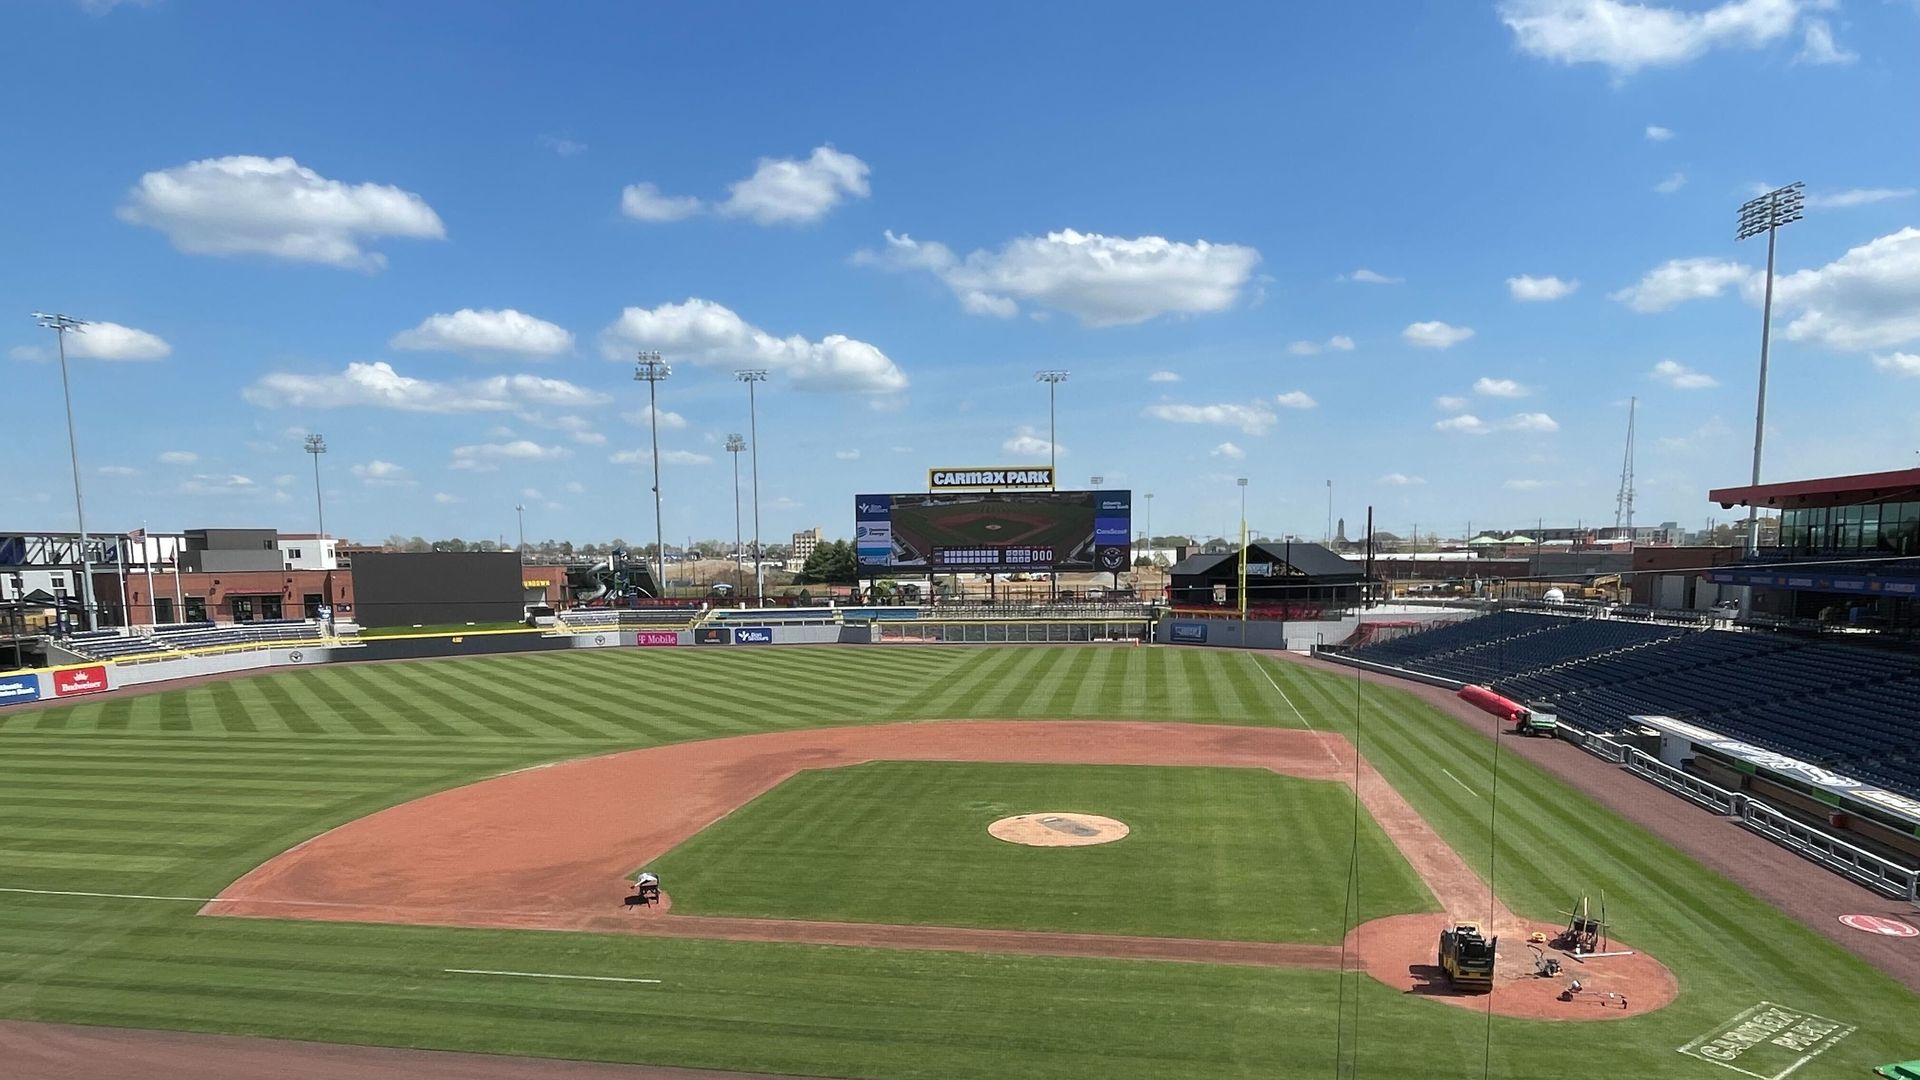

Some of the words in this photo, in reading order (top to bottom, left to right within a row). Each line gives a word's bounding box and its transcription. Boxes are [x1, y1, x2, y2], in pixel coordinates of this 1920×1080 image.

[1006, 471, 1050, 484] PARK
[647, 634, 676, 644] Mobile
[17, 687, 36, 695] Bank
[61, 681, 101, 692] Budweiser
